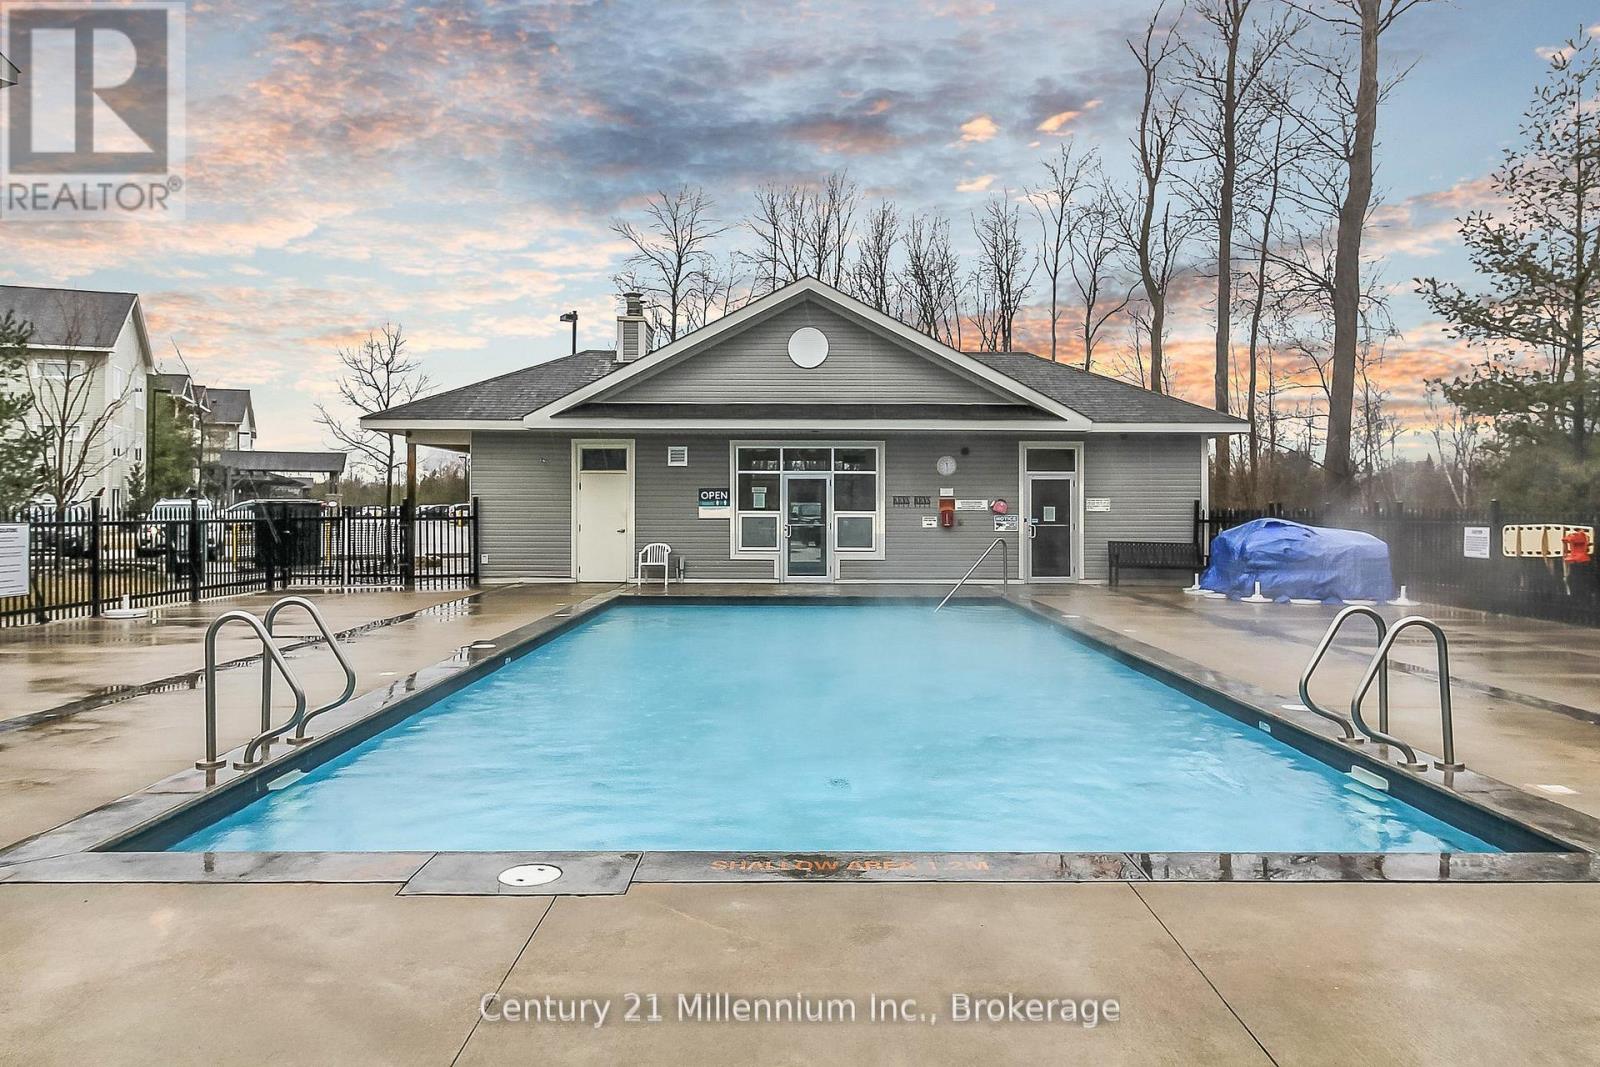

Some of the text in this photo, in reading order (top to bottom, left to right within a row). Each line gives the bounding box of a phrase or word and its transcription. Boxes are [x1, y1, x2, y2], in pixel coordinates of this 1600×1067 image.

[700, 491, 728, 500] OPEN
[710, 860, 838, 870] SHALLOW
[846, 860, 917, 870] AREA
